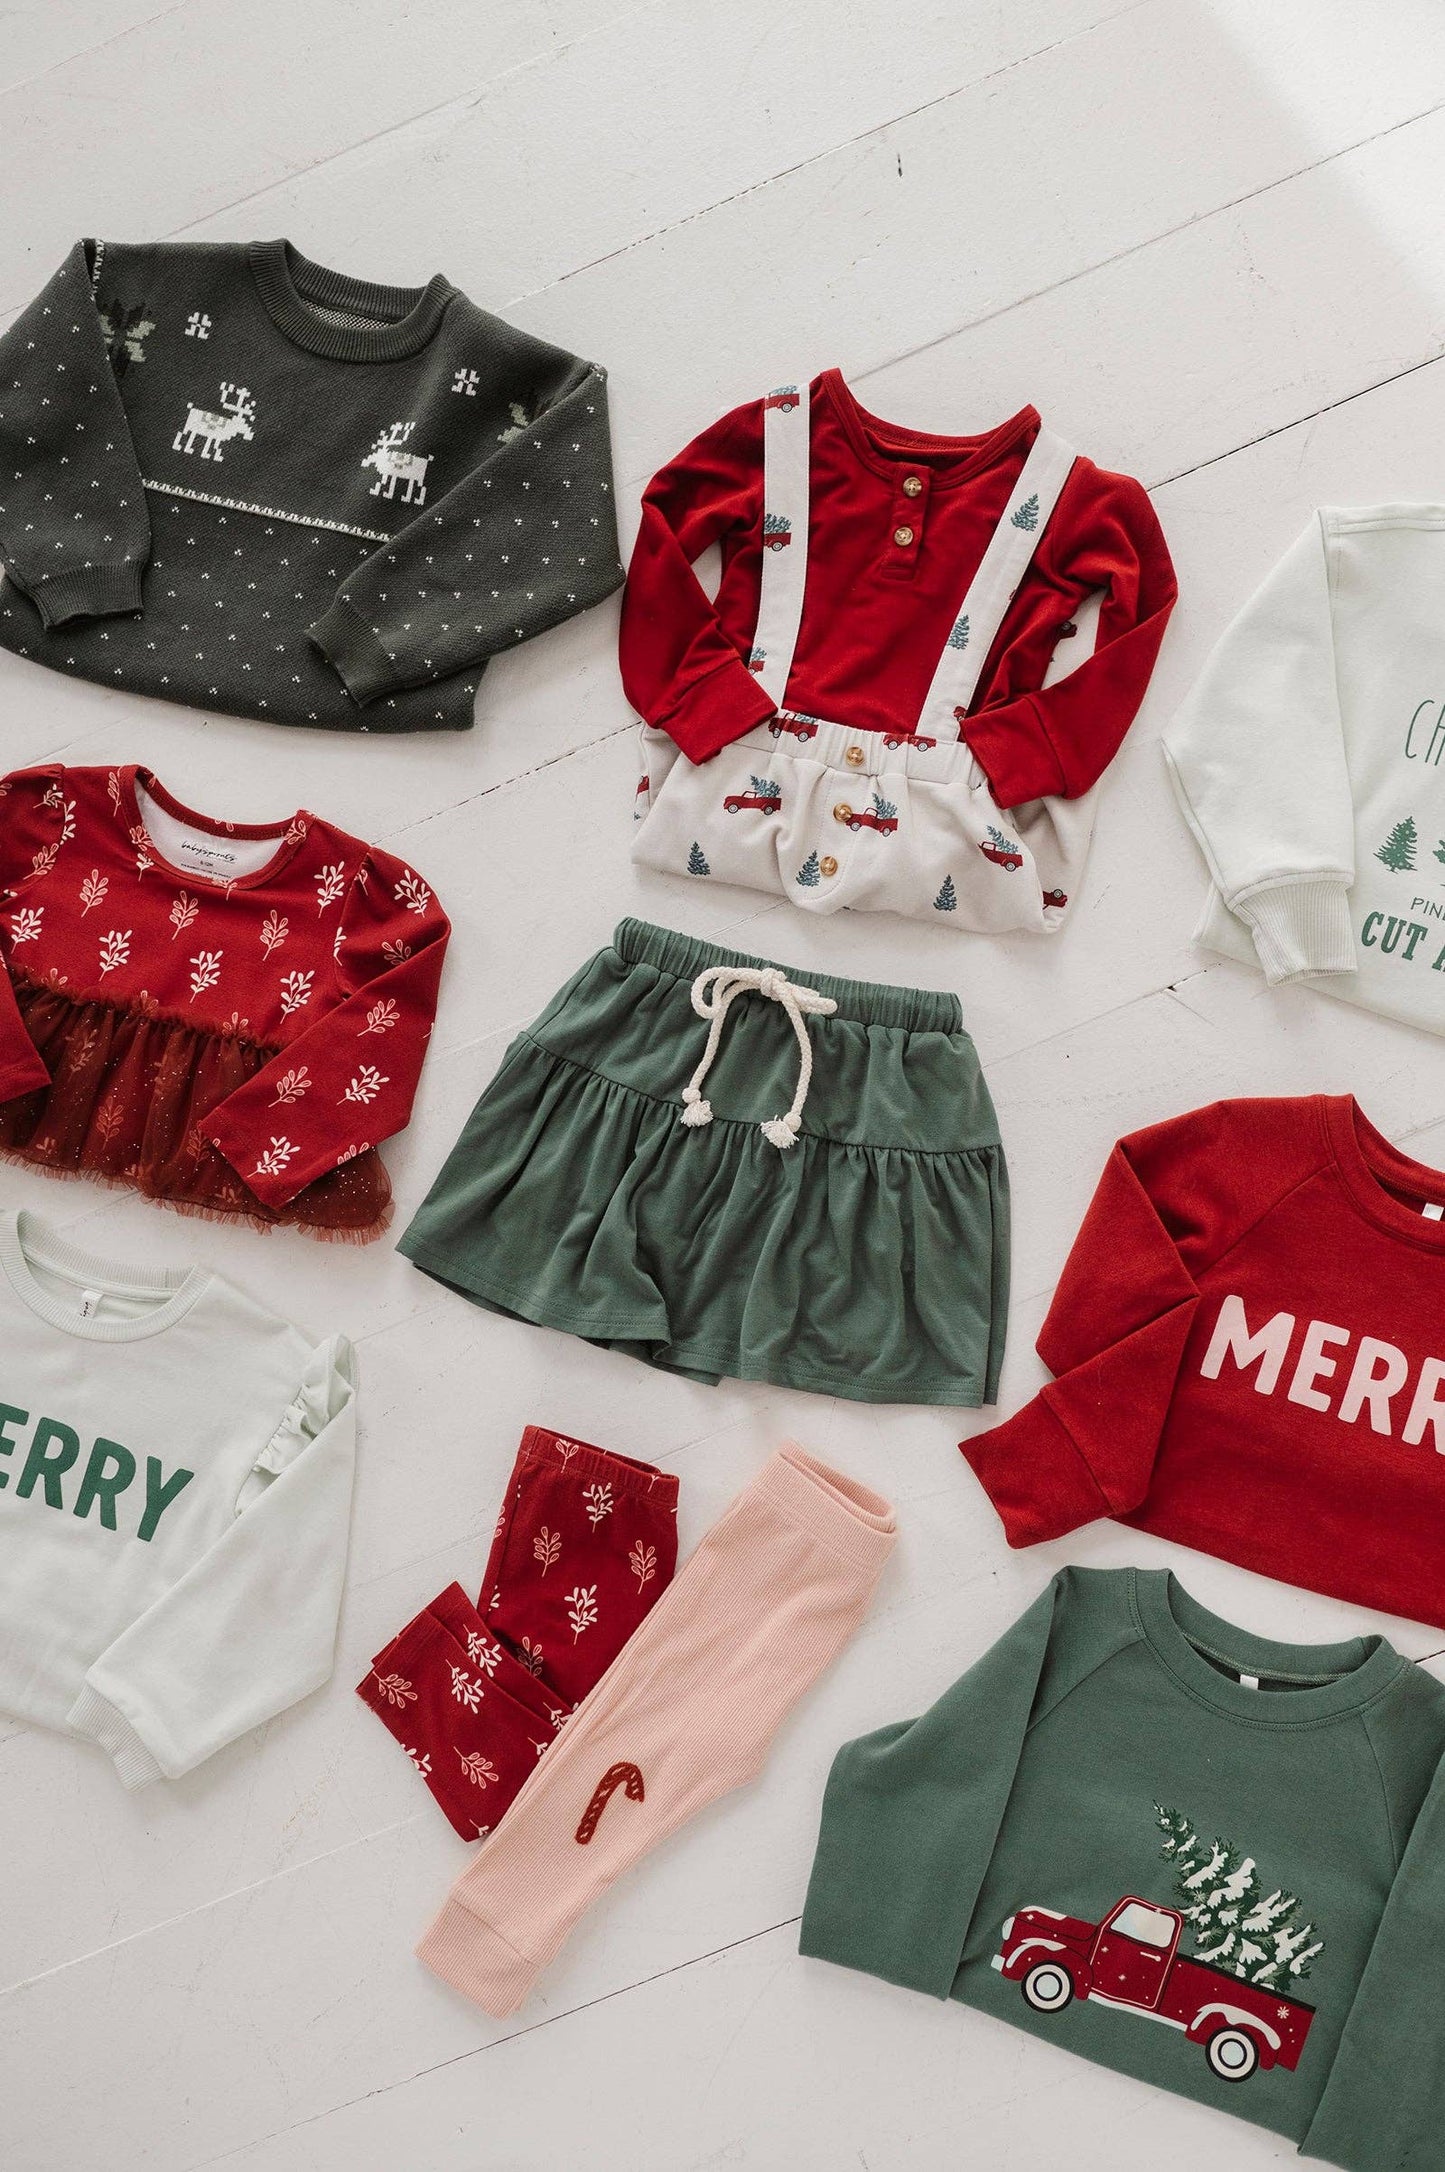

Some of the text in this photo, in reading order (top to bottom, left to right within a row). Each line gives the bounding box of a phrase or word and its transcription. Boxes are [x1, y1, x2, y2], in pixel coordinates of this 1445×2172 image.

[1410, 896, 1445, 921] PIN
[1361, 911, 1429, 961] CUT
[1200, 1294, 1445, 1456] MERR
